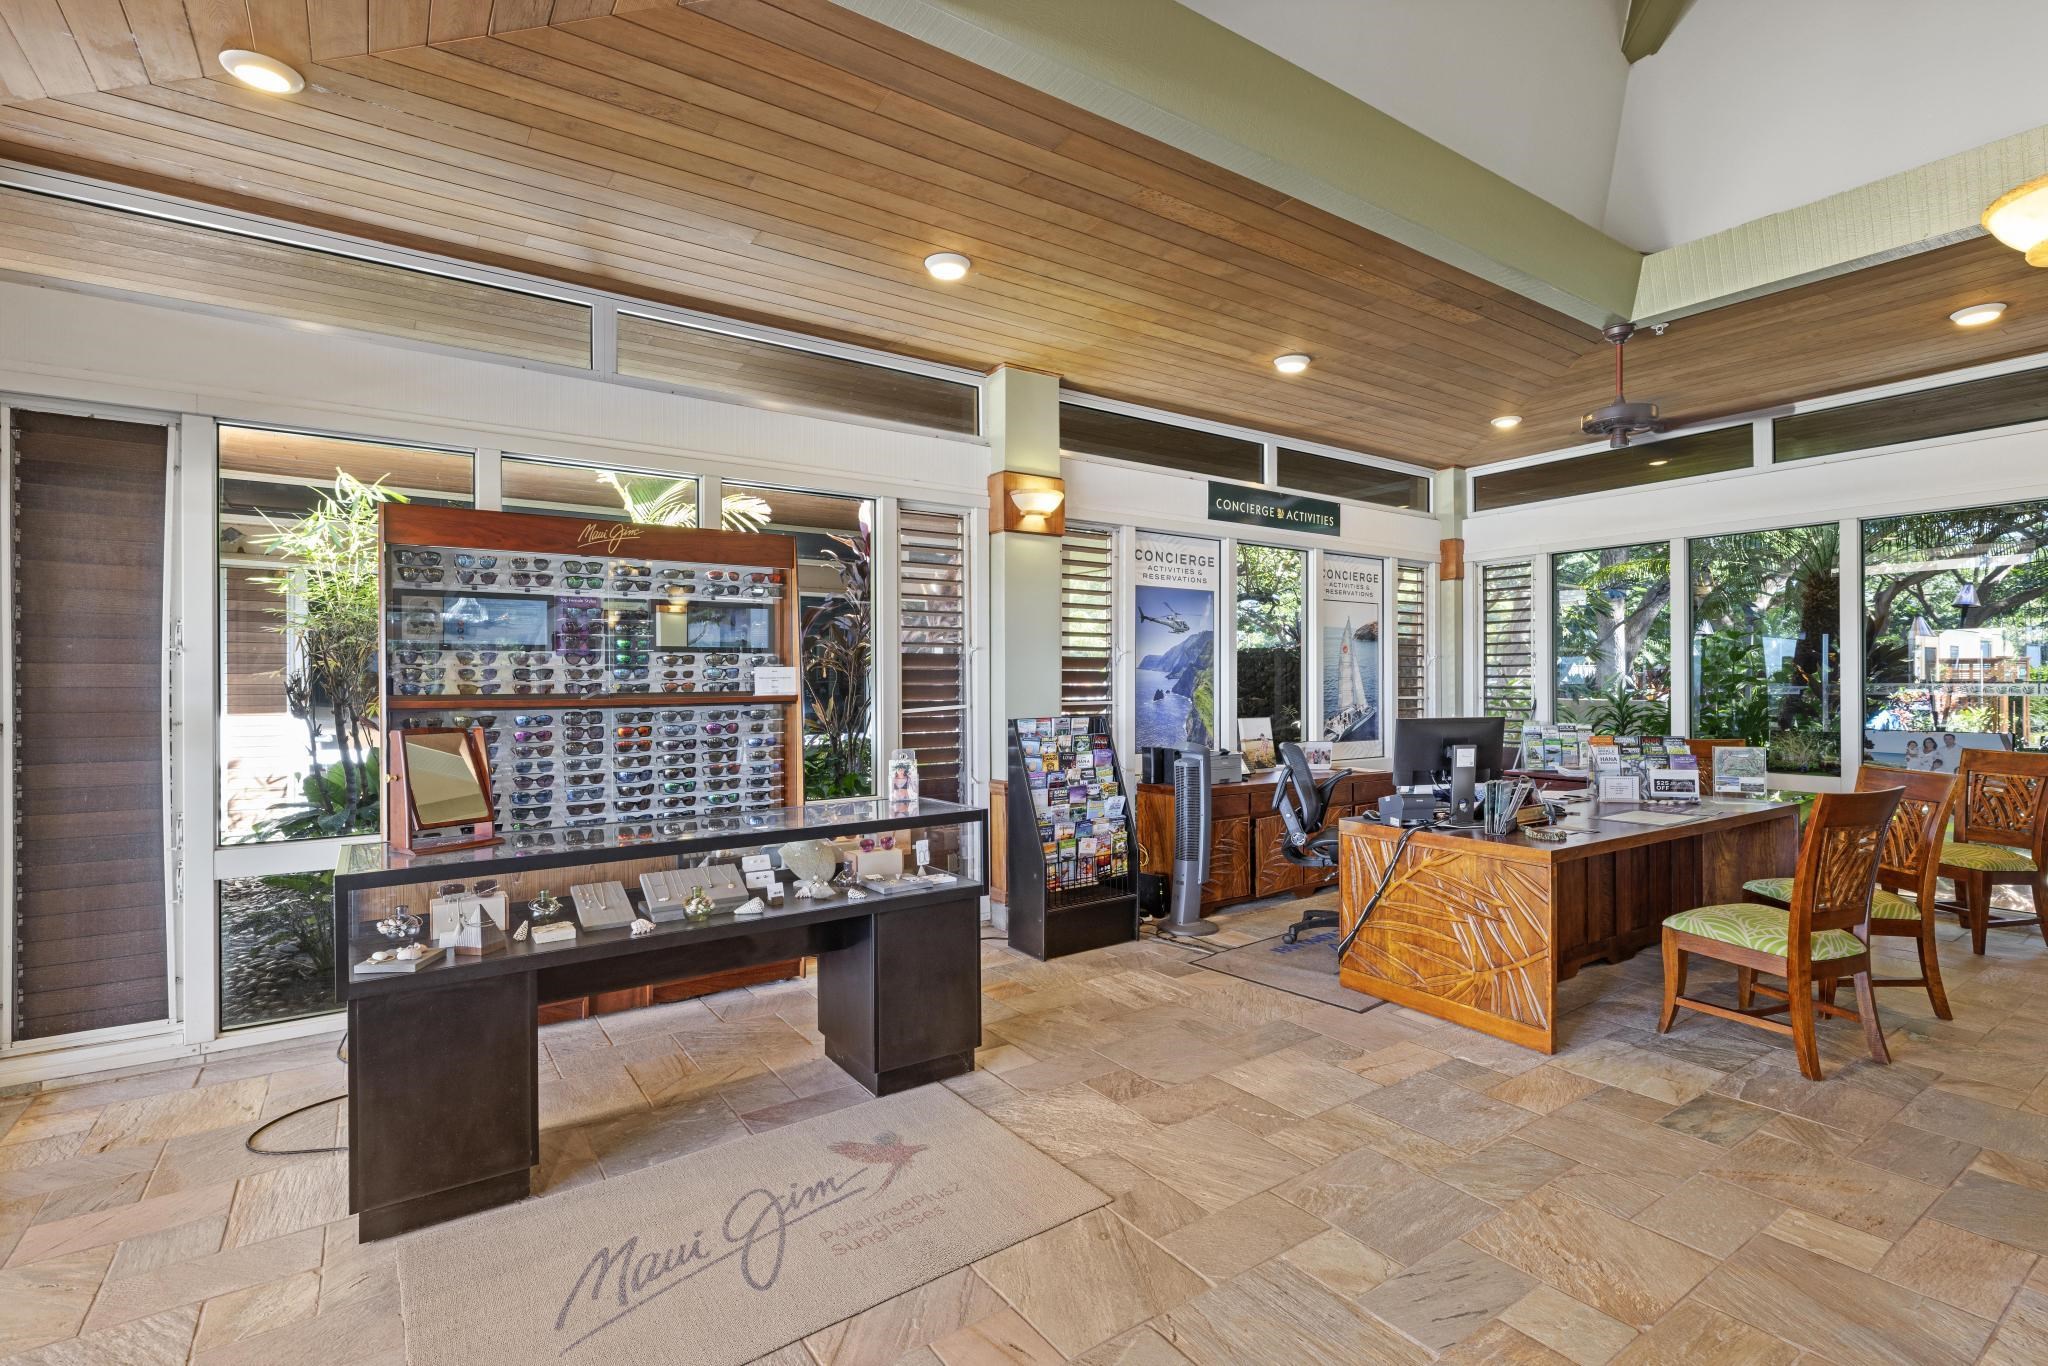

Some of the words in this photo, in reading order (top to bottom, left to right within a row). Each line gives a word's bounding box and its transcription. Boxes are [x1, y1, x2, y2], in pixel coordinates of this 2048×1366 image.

[1215, 498, 1275, 518] CONCIERGE
[1286, 510, 1334, 527] ACTIVITIES
[577, 523, 608, 542] Maui
[609, 523, 645, 554] Jim
[1134, 549, 1215, 568] CONCIERGE
[1142, 572, 1208, 584] RESERVATIONS
[1147, 565, 1195, 575] ACTIVITIES
[1322, 568, 1379, 584] ONCIERGE
[1325, 588, 1374, 598] RESERVATIONS
[1329, 582, 1364, 590] ACTIVITIES
[831, 1206, 946, 1256] Sunglasses
[554, 1226, 710, 1332] Maui
[723, 1167, 869, 1291] Jim
